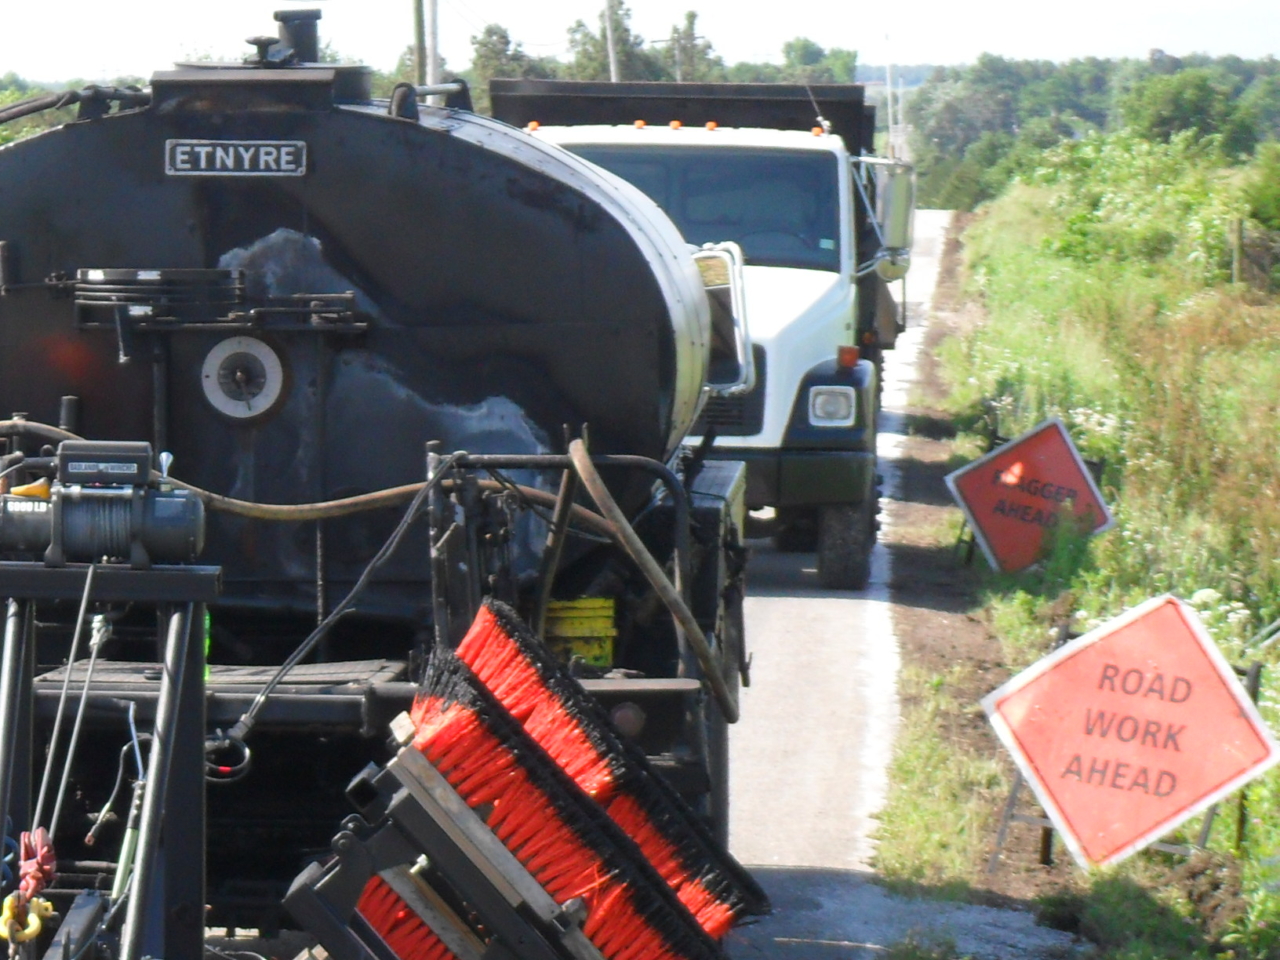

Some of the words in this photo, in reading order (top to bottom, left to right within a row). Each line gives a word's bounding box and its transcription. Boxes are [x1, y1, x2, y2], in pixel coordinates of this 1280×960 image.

[175, 146, 297, 170] ETNYRE
[993, 499, 1059, 528] AHEAD
[1098, 663, 1192, 703] ROAD
[1084, 707, 1187, 752] WORK
[1060, 753, 1178, 798] AHEAD
